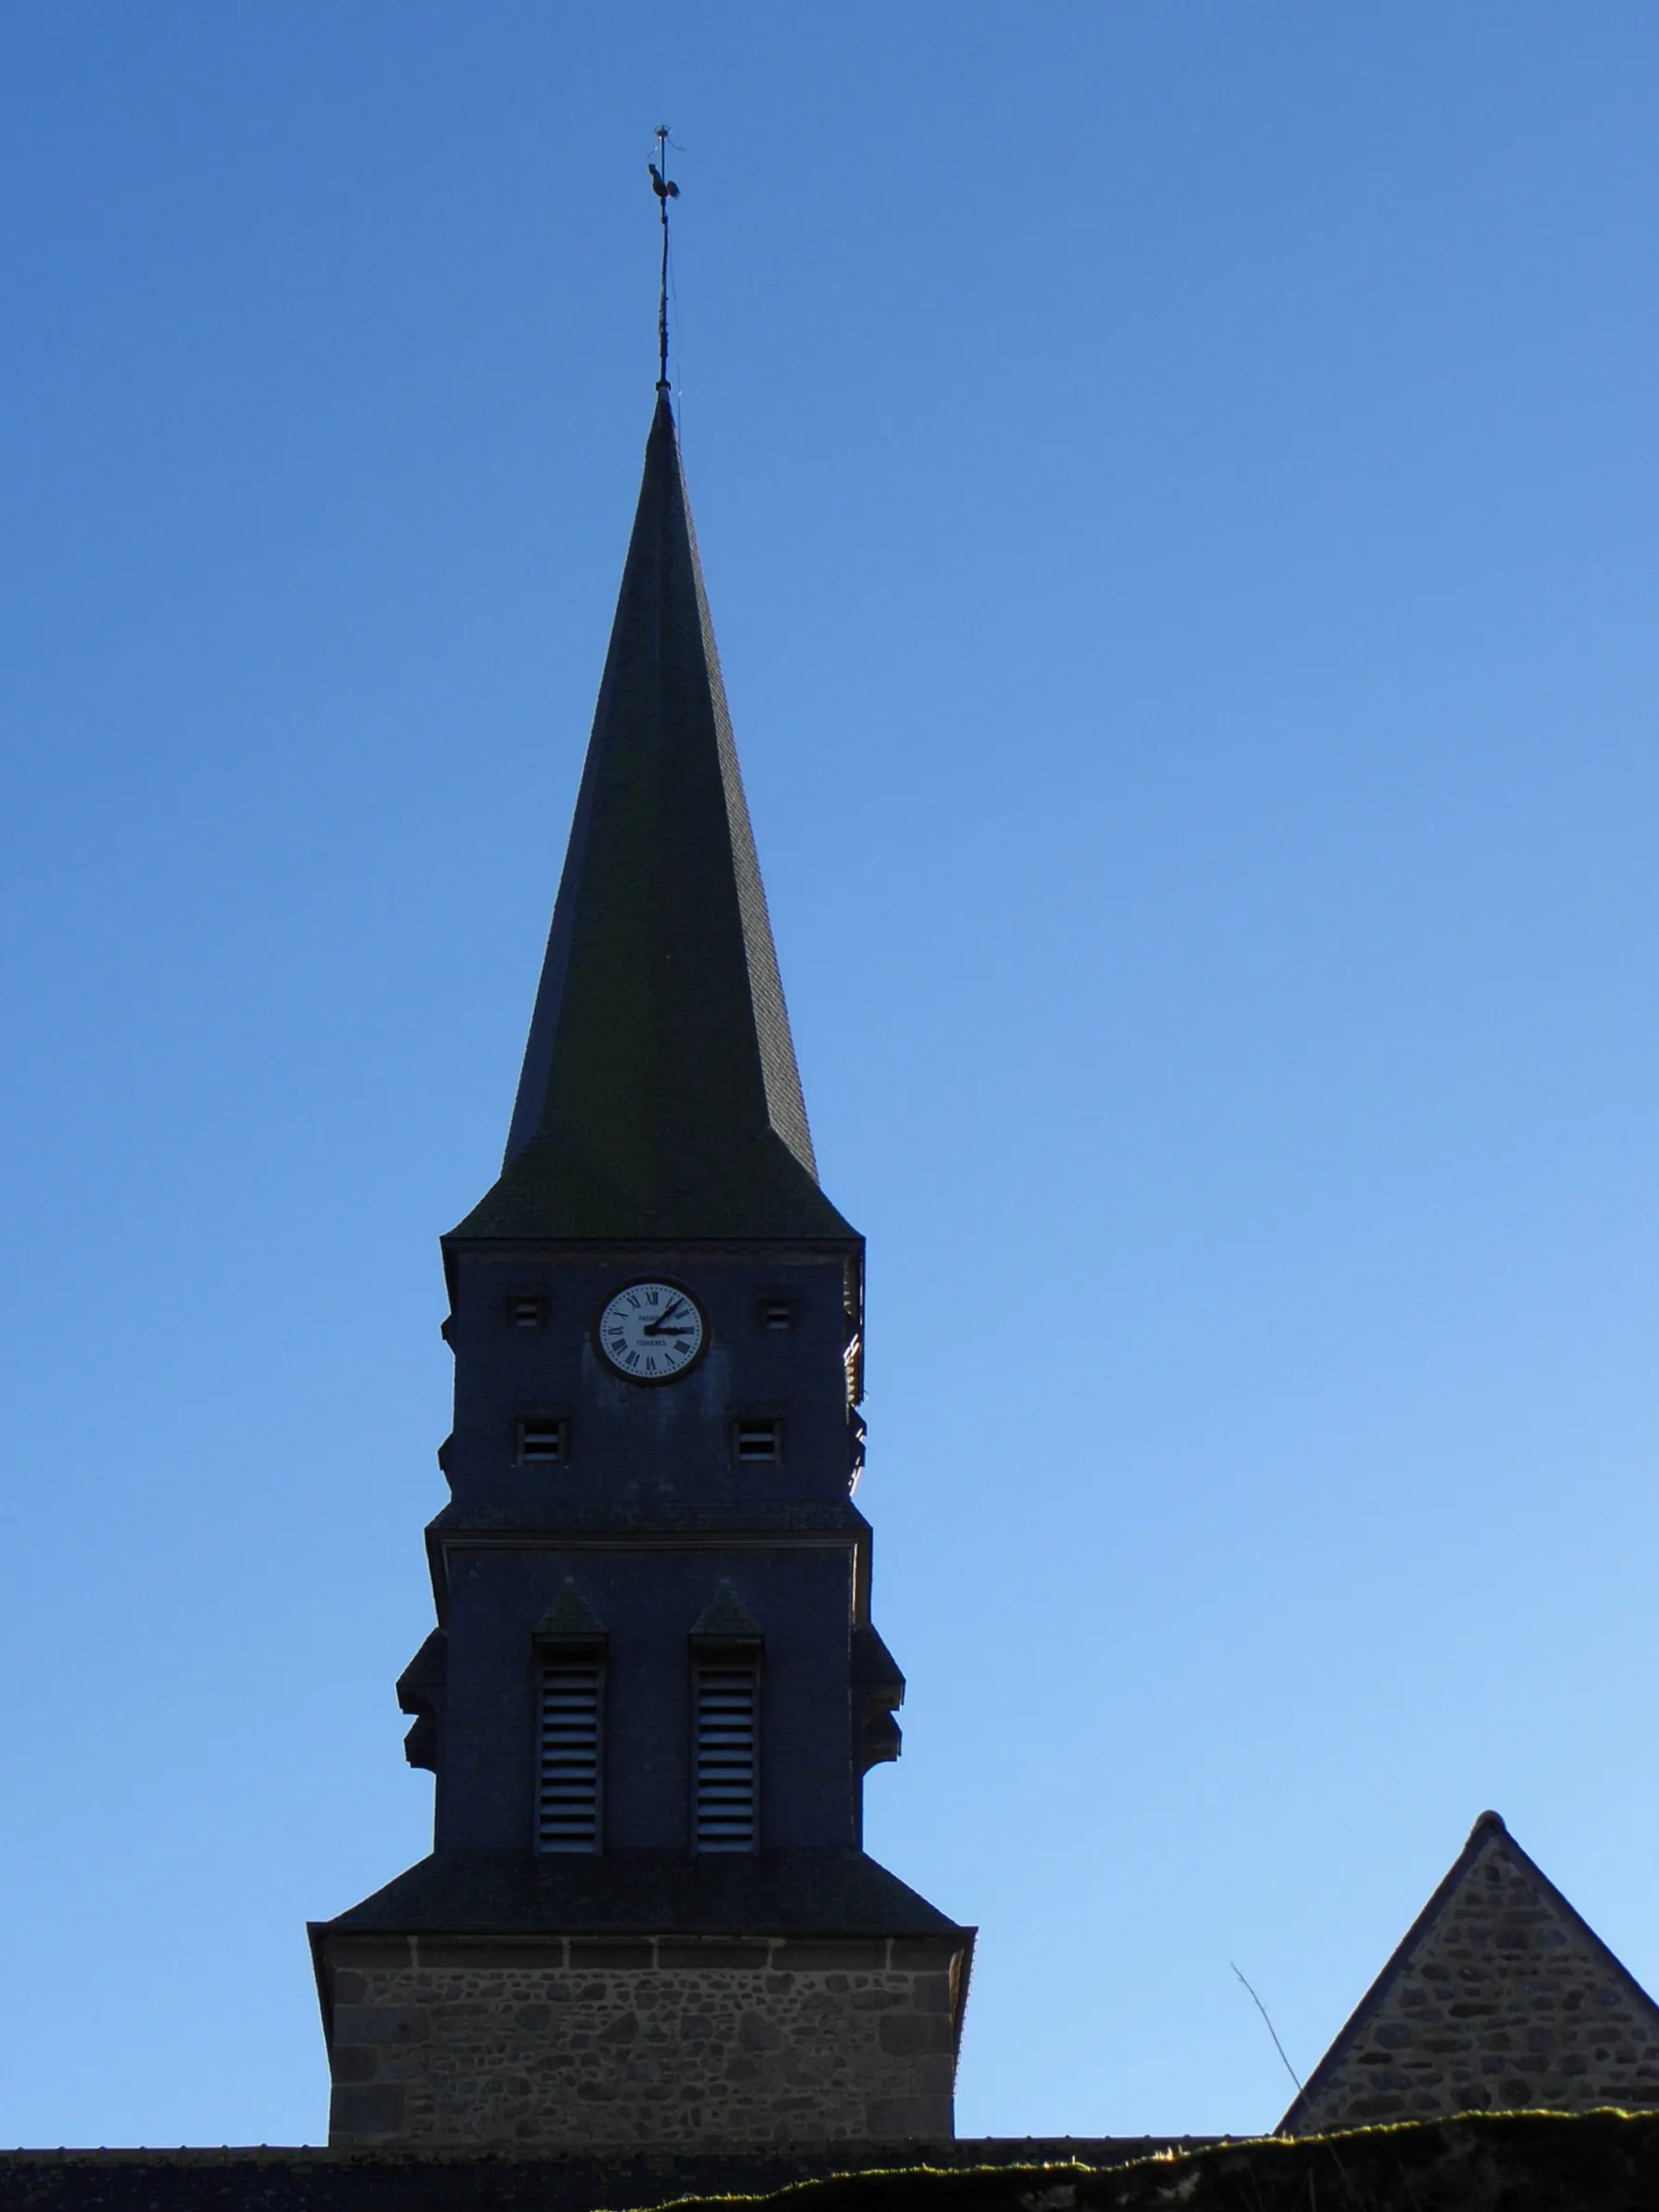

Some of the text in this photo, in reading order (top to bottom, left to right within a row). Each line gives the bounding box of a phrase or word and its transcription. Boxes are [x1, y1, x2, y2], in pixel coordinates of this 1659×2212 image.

[646, 1292, 659, 1305] XII
[613, 1308, 629, 1320] X
[664, 1353, 675, 1367] V
